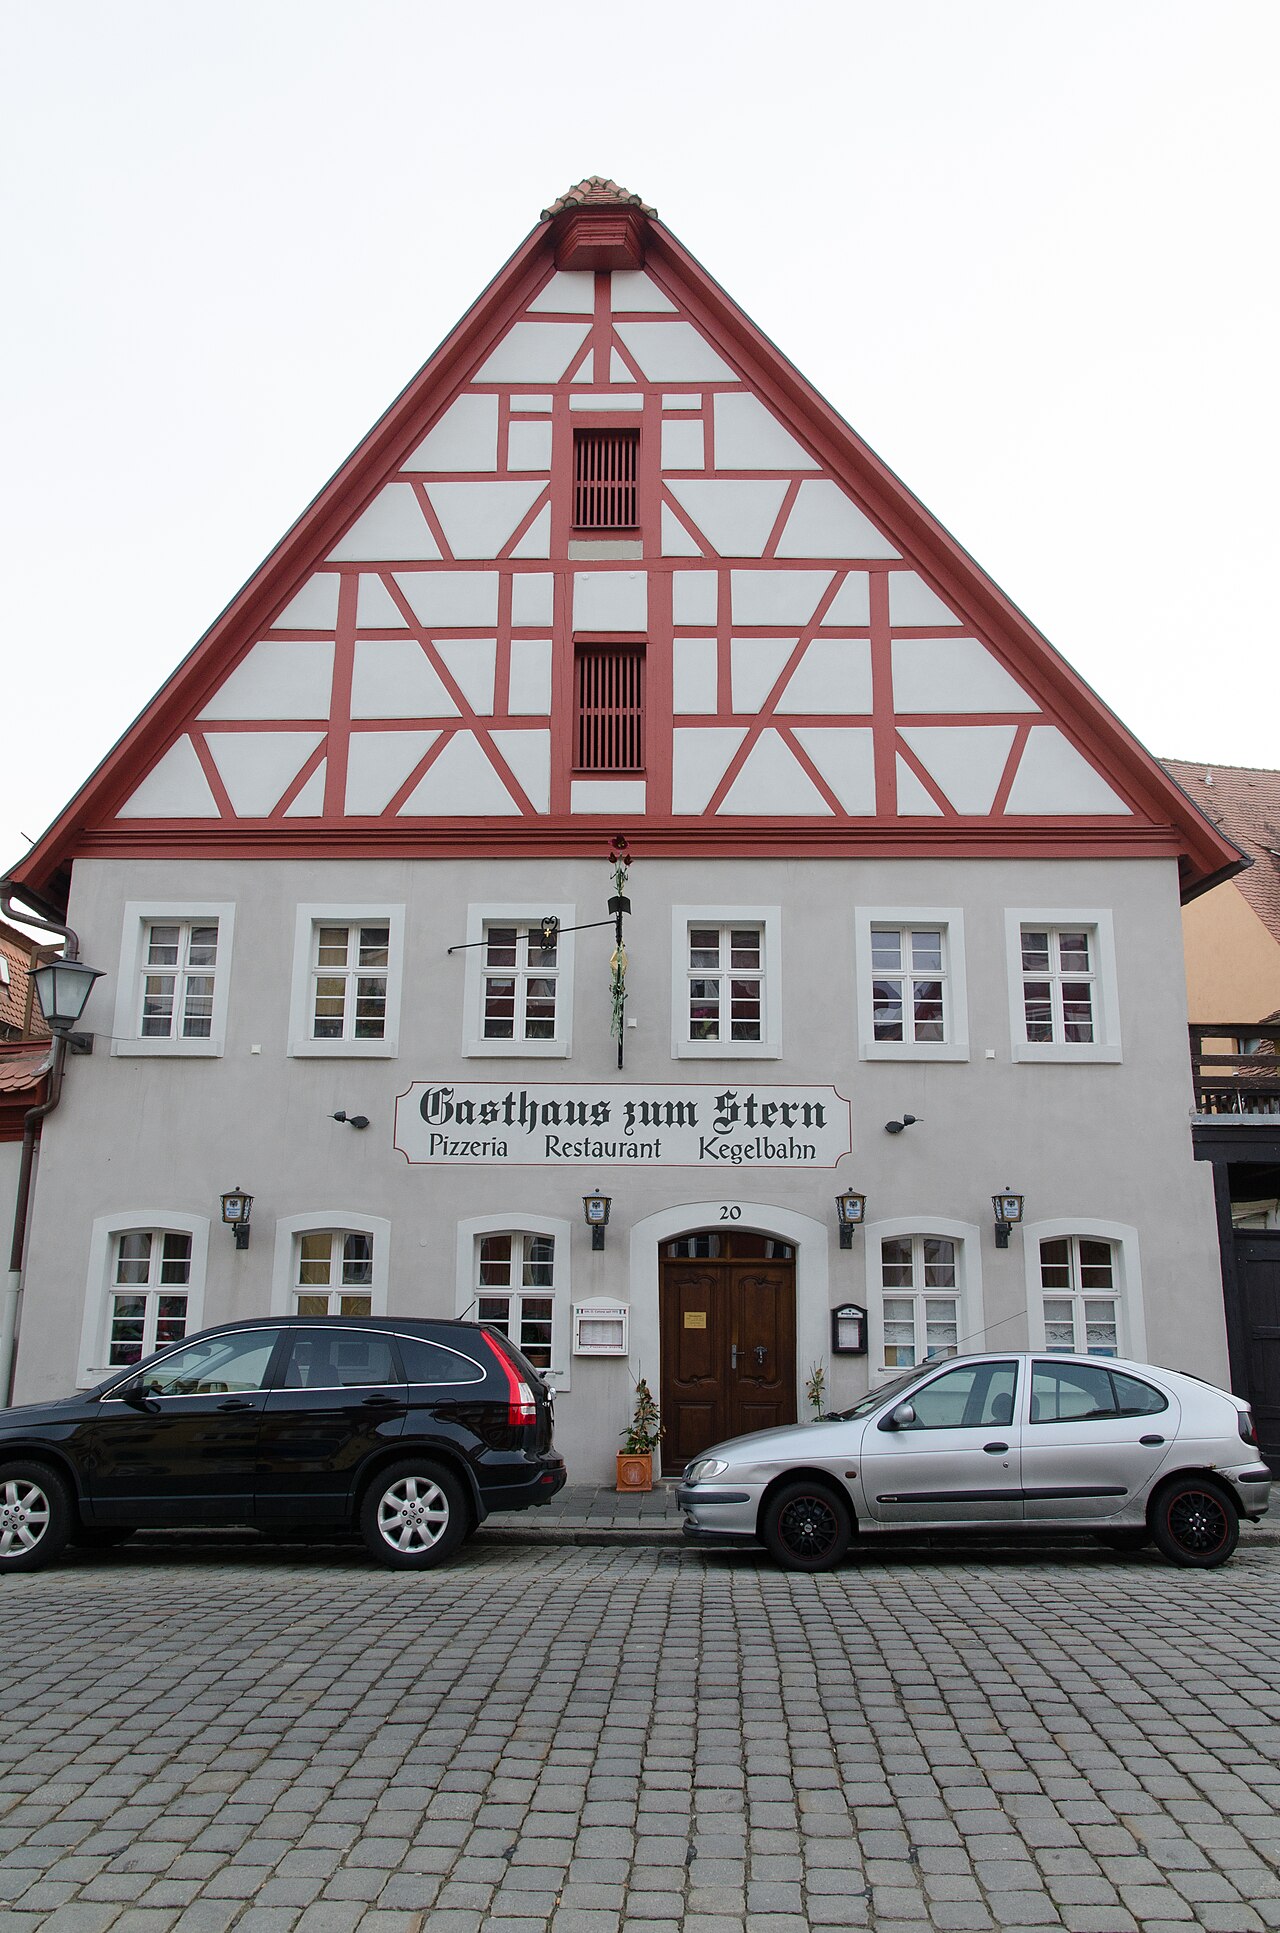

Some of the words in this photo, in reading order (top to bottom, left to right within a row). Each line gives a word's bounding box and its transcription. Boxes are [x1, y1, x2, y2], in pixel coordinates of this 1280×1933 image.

[420, 1087, 611, 1134] Gasthaus
[623, 1100, 699, 1136] zum
[713, 1090, 827, 1136] Stern
[429, 1133, 508, 1158] Pizzeria
[545, 1134, 661, 1159] Restaurant
[699, 1136, 816, 1165] Kegelbahn
[719, 1205, 742, 1220] 20
